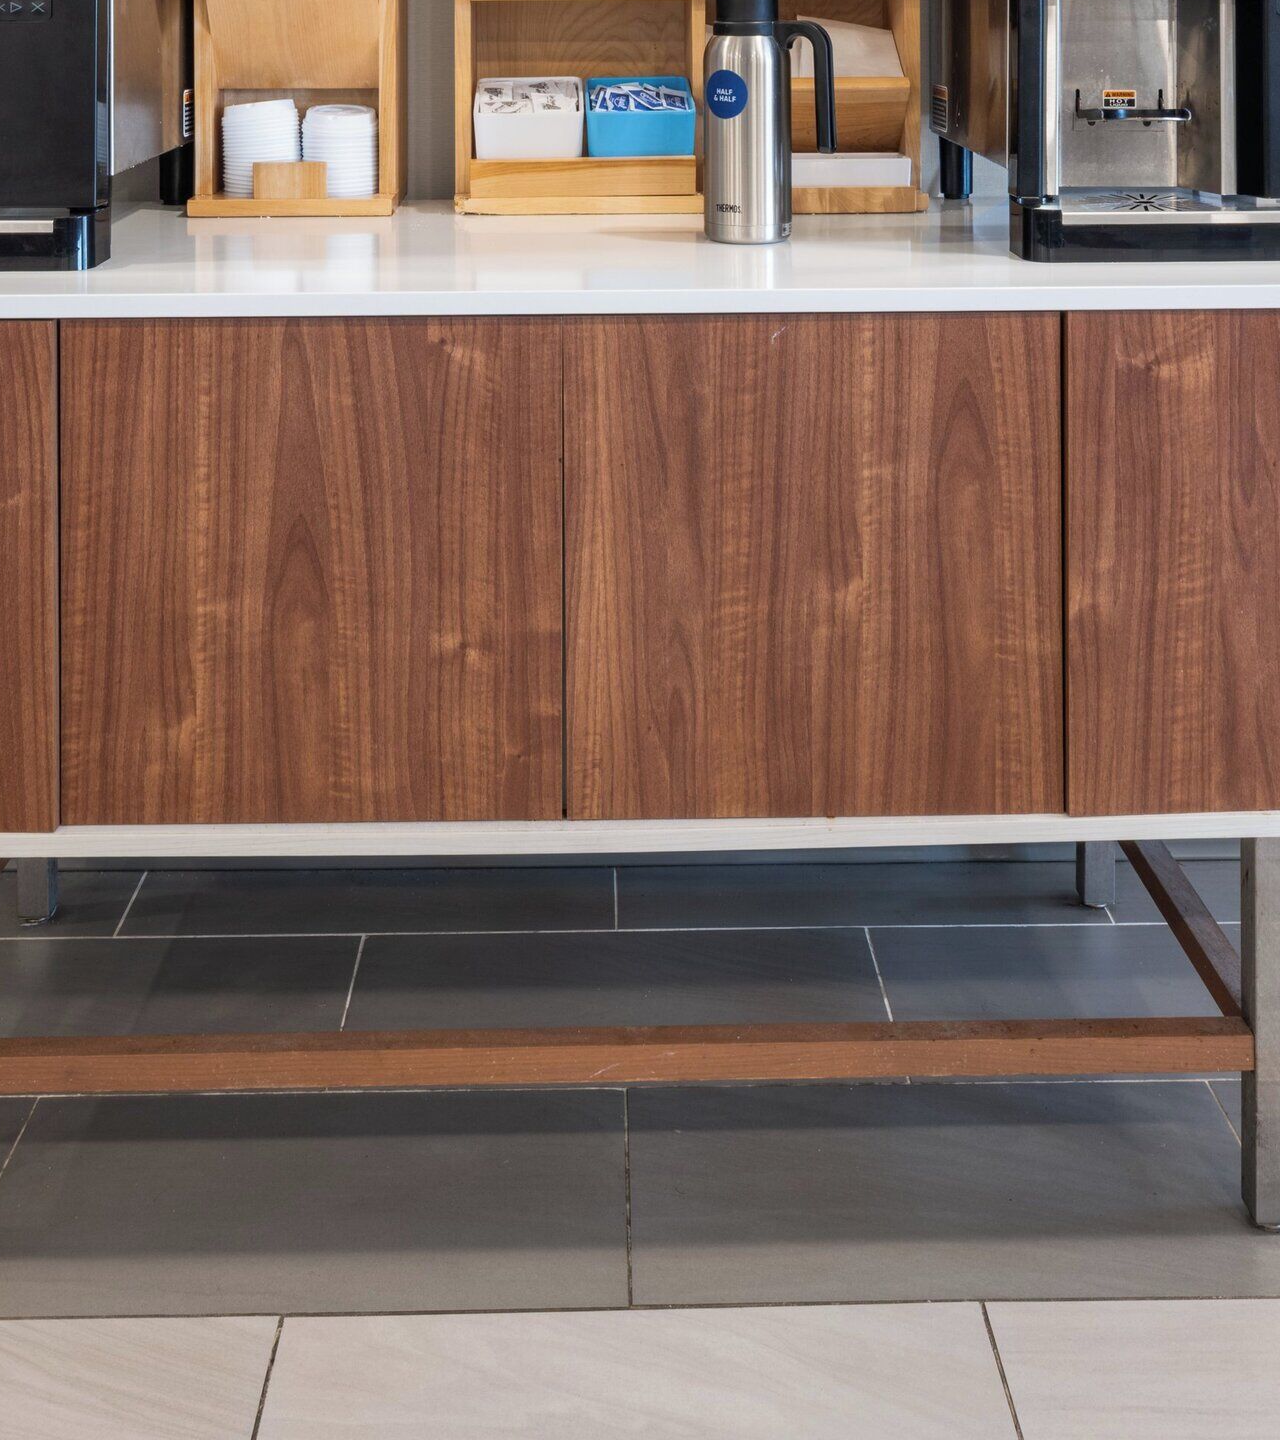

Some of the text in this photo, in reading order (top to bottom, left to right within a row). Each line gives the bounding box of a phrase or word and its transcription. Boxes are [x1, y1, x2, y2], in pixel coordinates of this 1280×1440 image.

[716, 87, 733, 95] HALF
[719, 95, 737, 103] HALF
[716, 203, 742, 214] THERMOS
